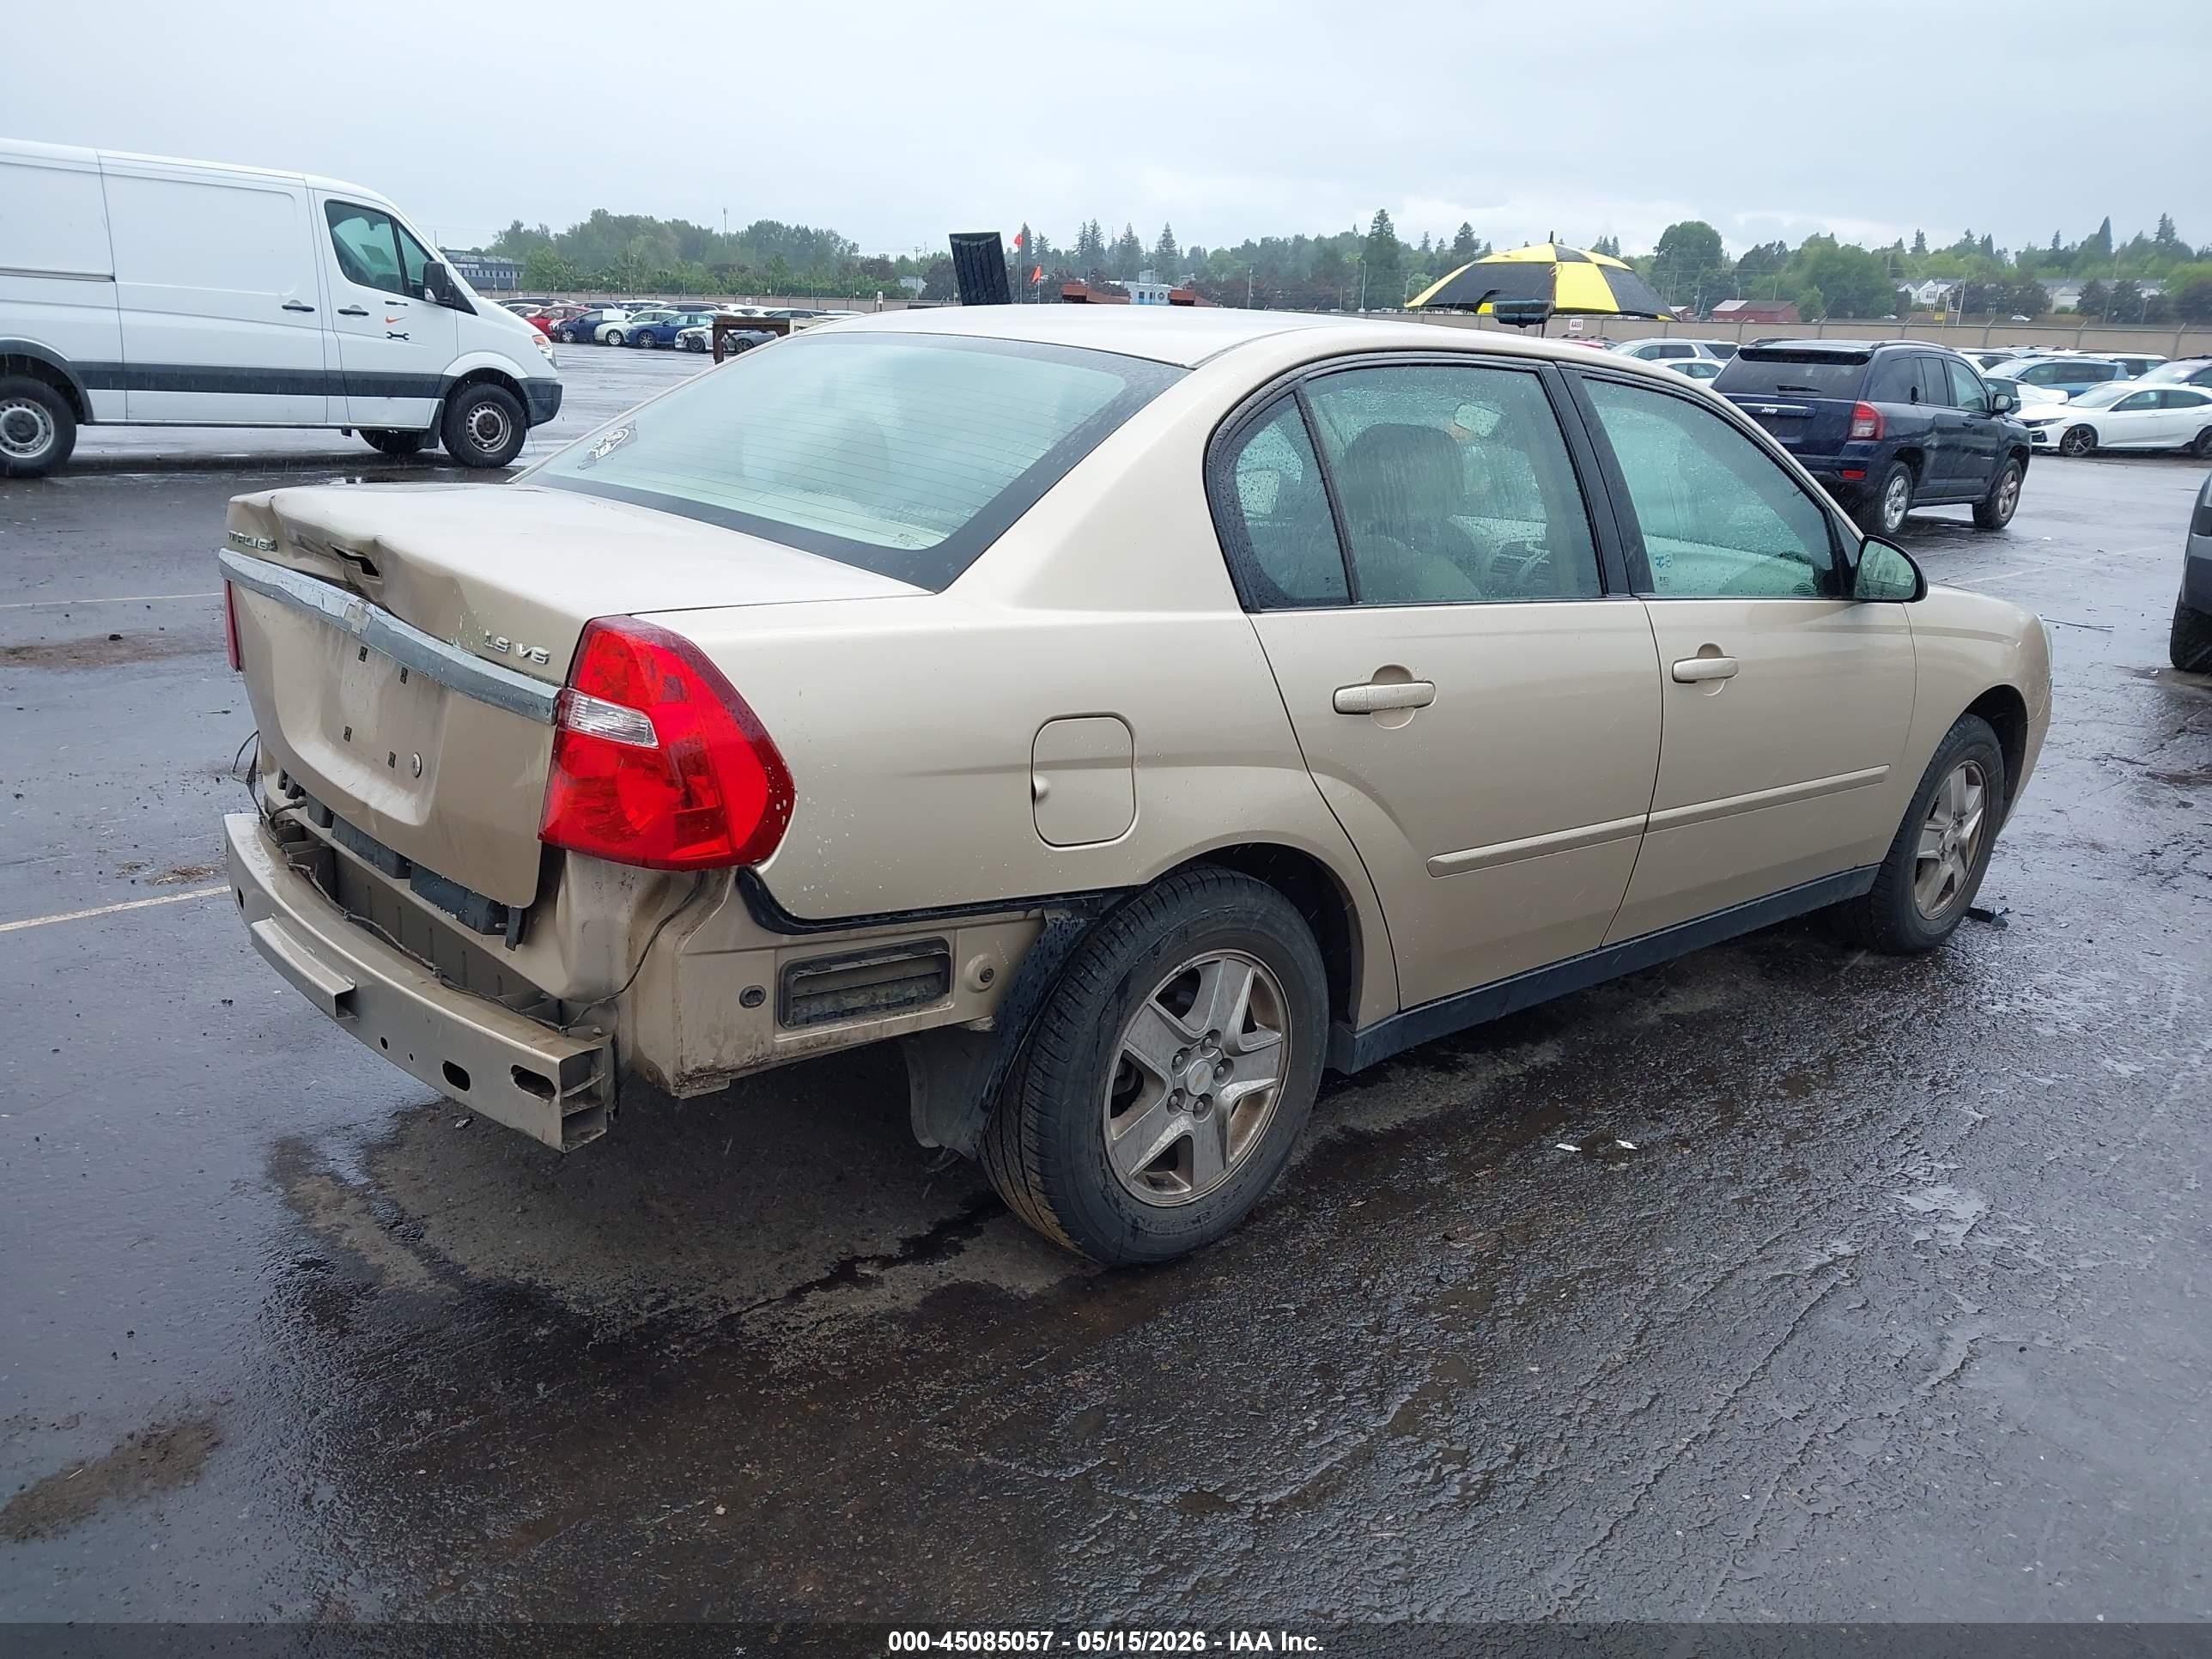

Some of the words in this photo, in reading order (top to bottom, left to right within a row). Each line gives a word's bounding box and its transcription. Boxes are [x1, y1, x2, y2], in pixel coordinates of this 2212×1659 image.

[1761, 406, 1778, 415] Jeep
[484, 629, 511, 653] LS
[515, 642, 550, 665] V6
